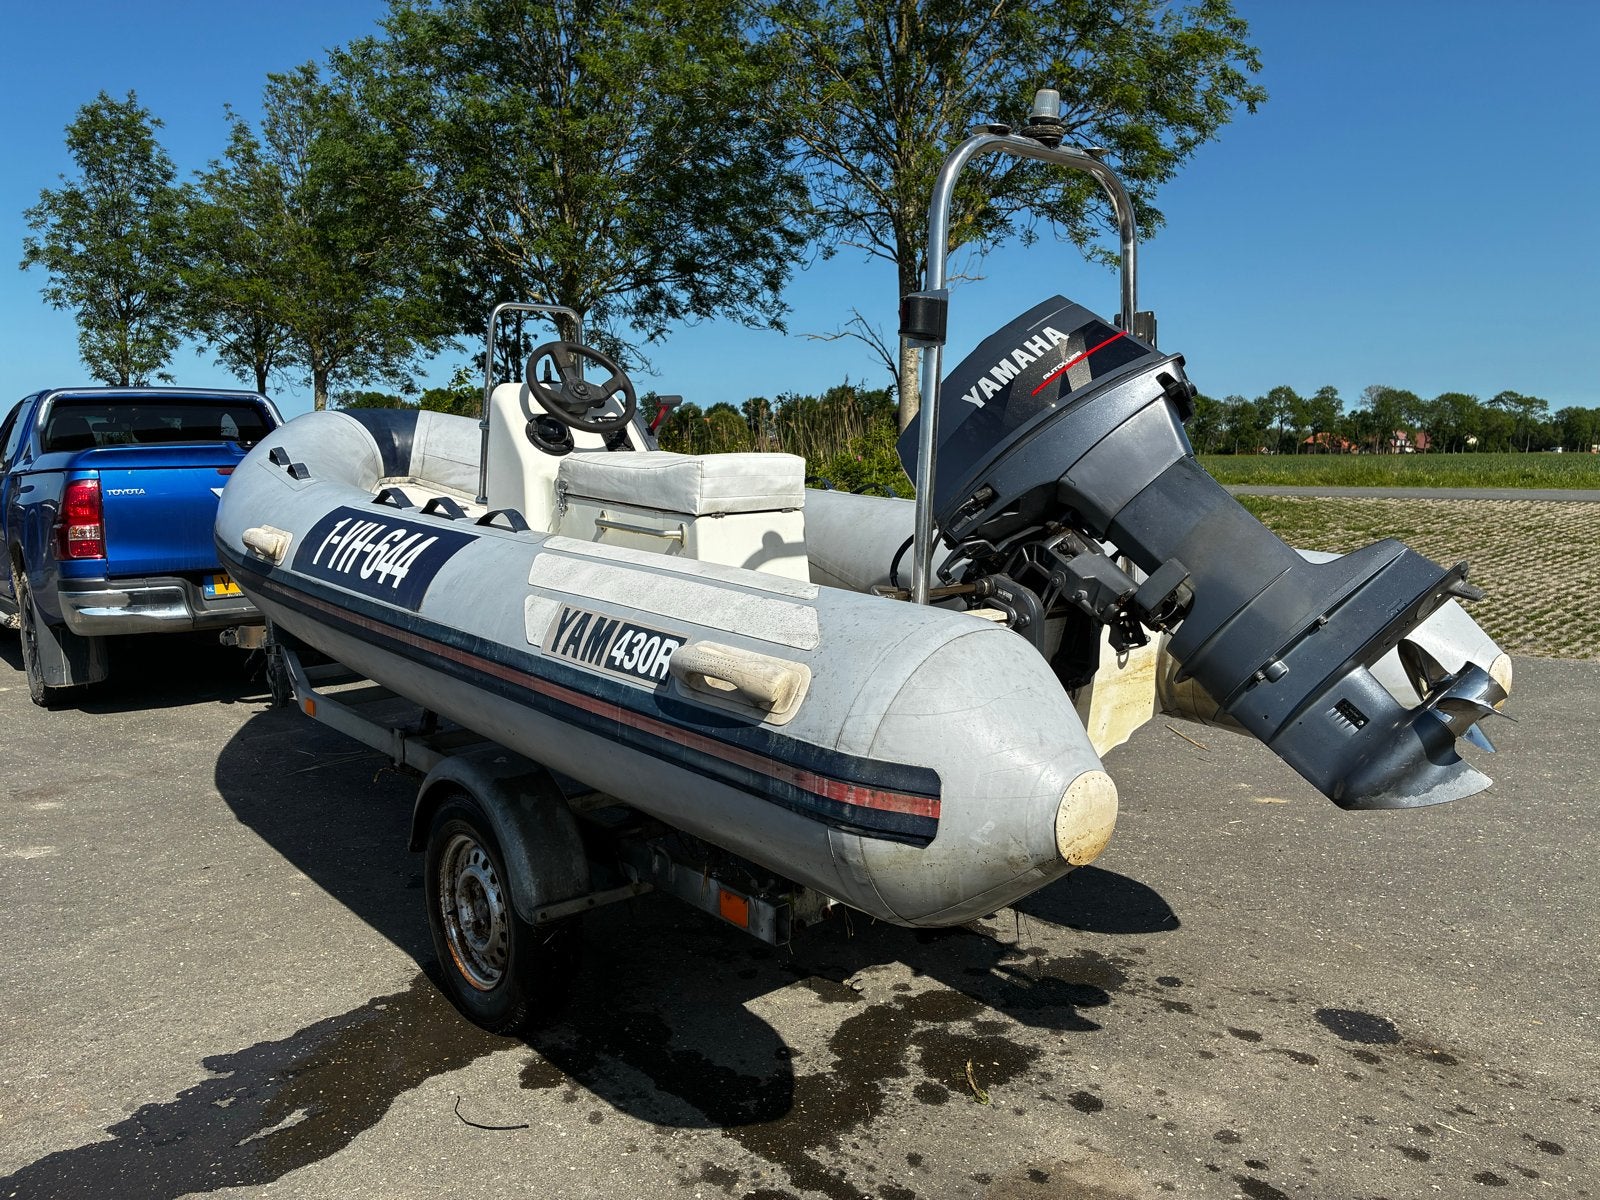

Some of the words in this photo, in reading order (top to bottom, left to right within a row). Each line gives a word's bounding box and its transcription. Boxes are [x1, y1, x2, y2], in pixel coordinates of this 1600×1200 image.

[962, 326, 1069, 409] YAMAHA
[106, 488, 146, 496] TOYOTA
[312, 517, 439, 589] 1-YH-644
[551, 607, 621, 667] YAM
[611, 629, 680, 681] 430R
